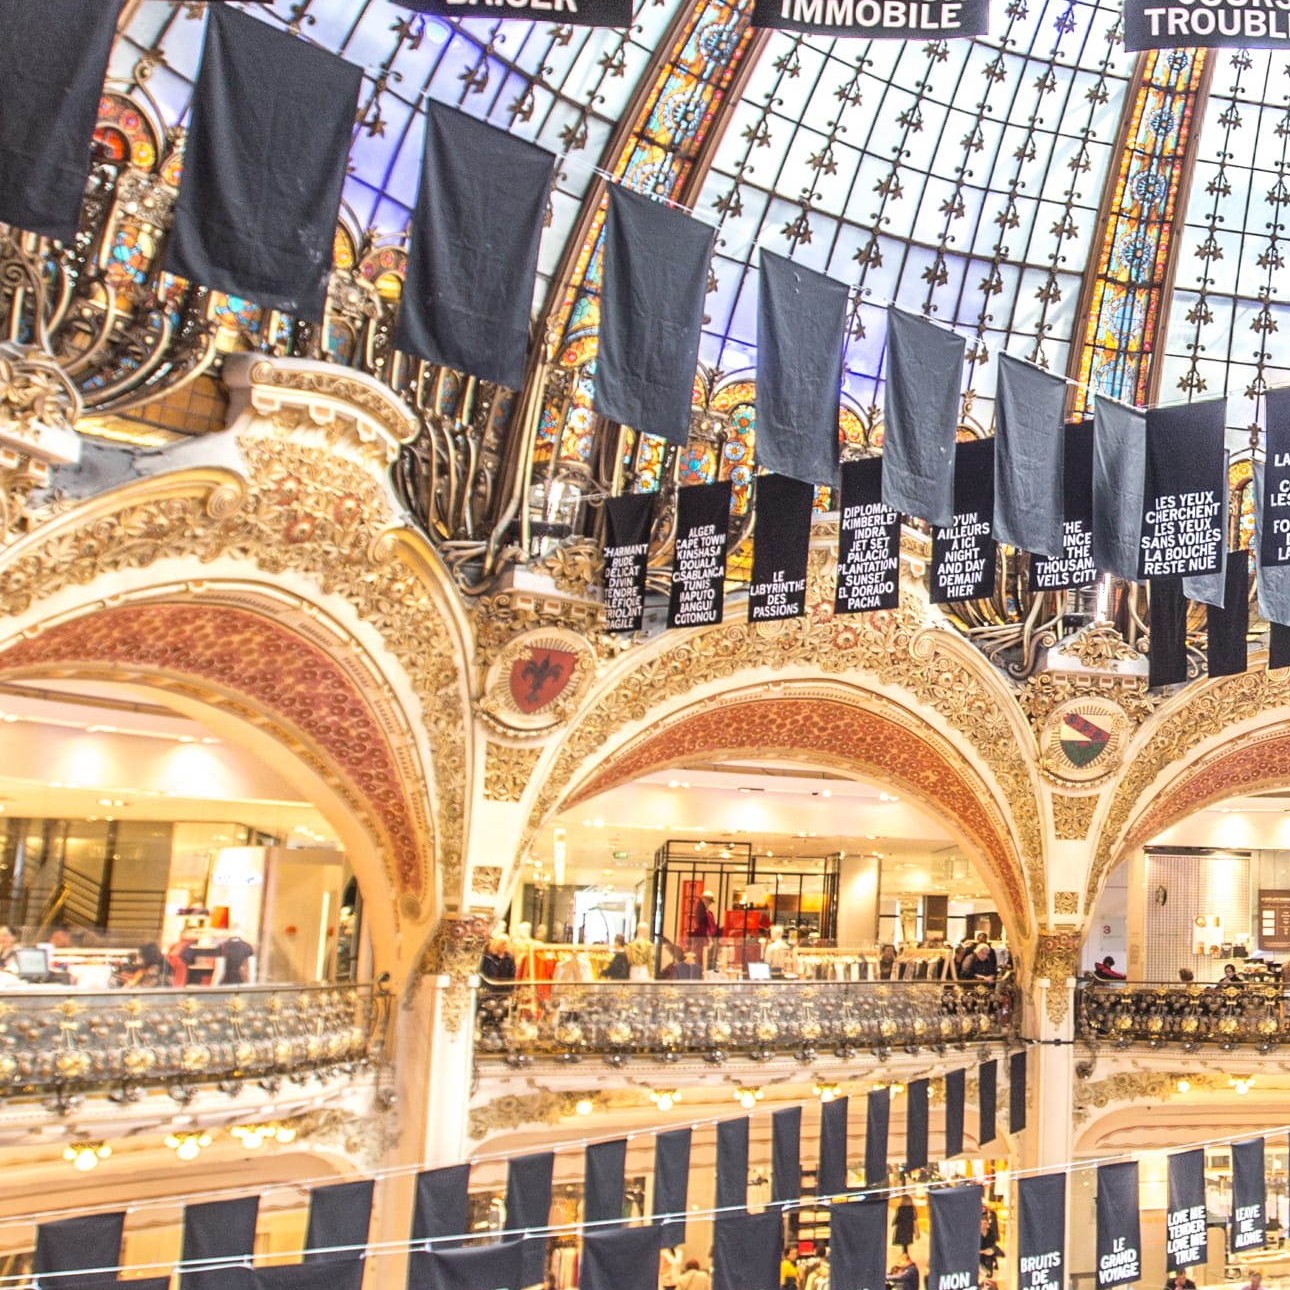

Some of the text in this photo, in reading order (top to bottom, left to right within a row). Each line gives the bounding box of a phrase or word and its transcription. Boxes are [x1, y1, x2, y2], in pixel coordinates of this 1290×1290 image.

[1156, 491, 1214, 510] LES YEUX
[1145, 502, 1220, 524] CHERCHENT
[1154, 517, 1211, 536] LES YEUX
[1141, 535, 1175, 549] SANS
[1145, 542, 1216, 562] LA BOUCHE
[1144, 556, 1216, 575] RESTE NUE
[773, 571, 784, 582] LE
[750, 579, 805, 596] LABYRINTHE
[767, 593, 786, 605] DES
[753, 603, 799, 618] PASSIONS
[1103, 925, 1111, 934] 3
[1113, 1237, 1125, 1253] LE
[1021, 1251, 1060, 1273] BRUITS
[1101, 1249, 1137, 1269] GRAND
[939, 1272, 970, 1290] MON
[1032, 1269, 1049, 1285] DE
[1099, 1262, 1139, 1284] VOYAGE
